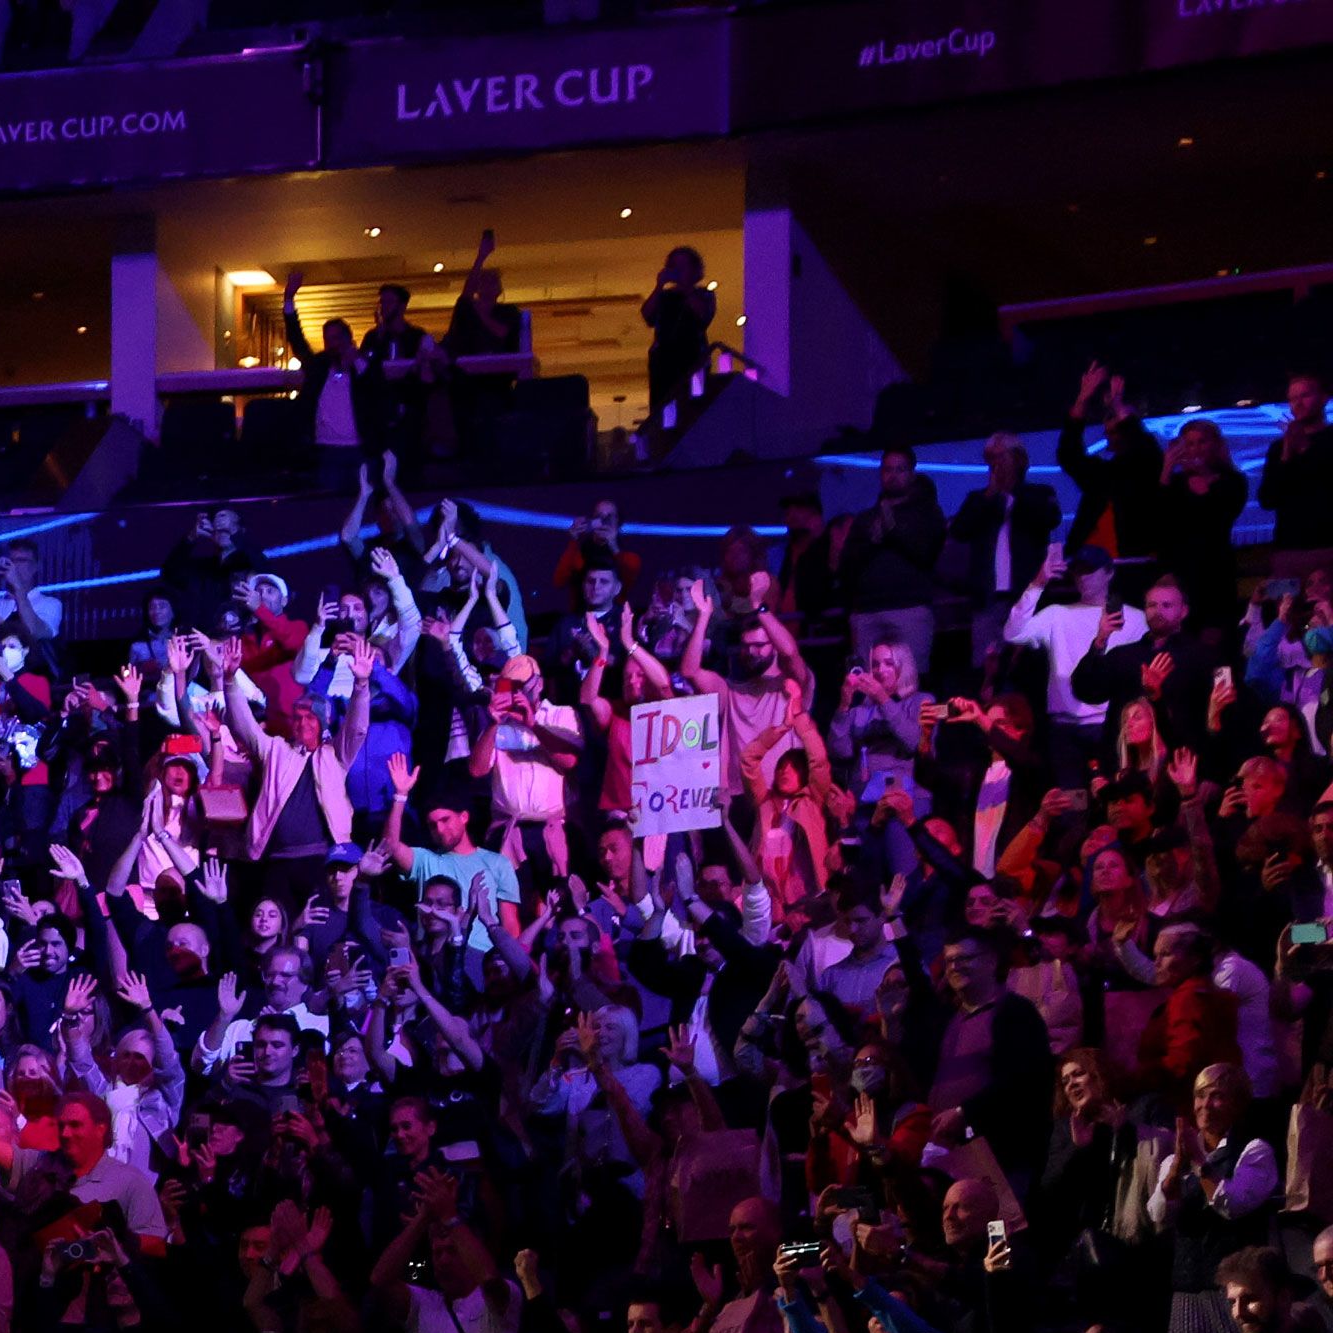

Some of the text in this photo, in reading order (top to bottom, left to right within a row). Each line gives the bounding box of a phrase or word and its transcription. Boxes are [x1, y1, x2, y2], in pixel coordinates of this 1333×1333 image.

[859, 29, 995, 67] #LaverCup
[398, 64, 654, 119] LAVER CUP
[61, 110, 186, 140] CUP.COM
[635, 710, 718, 766] IDOL
